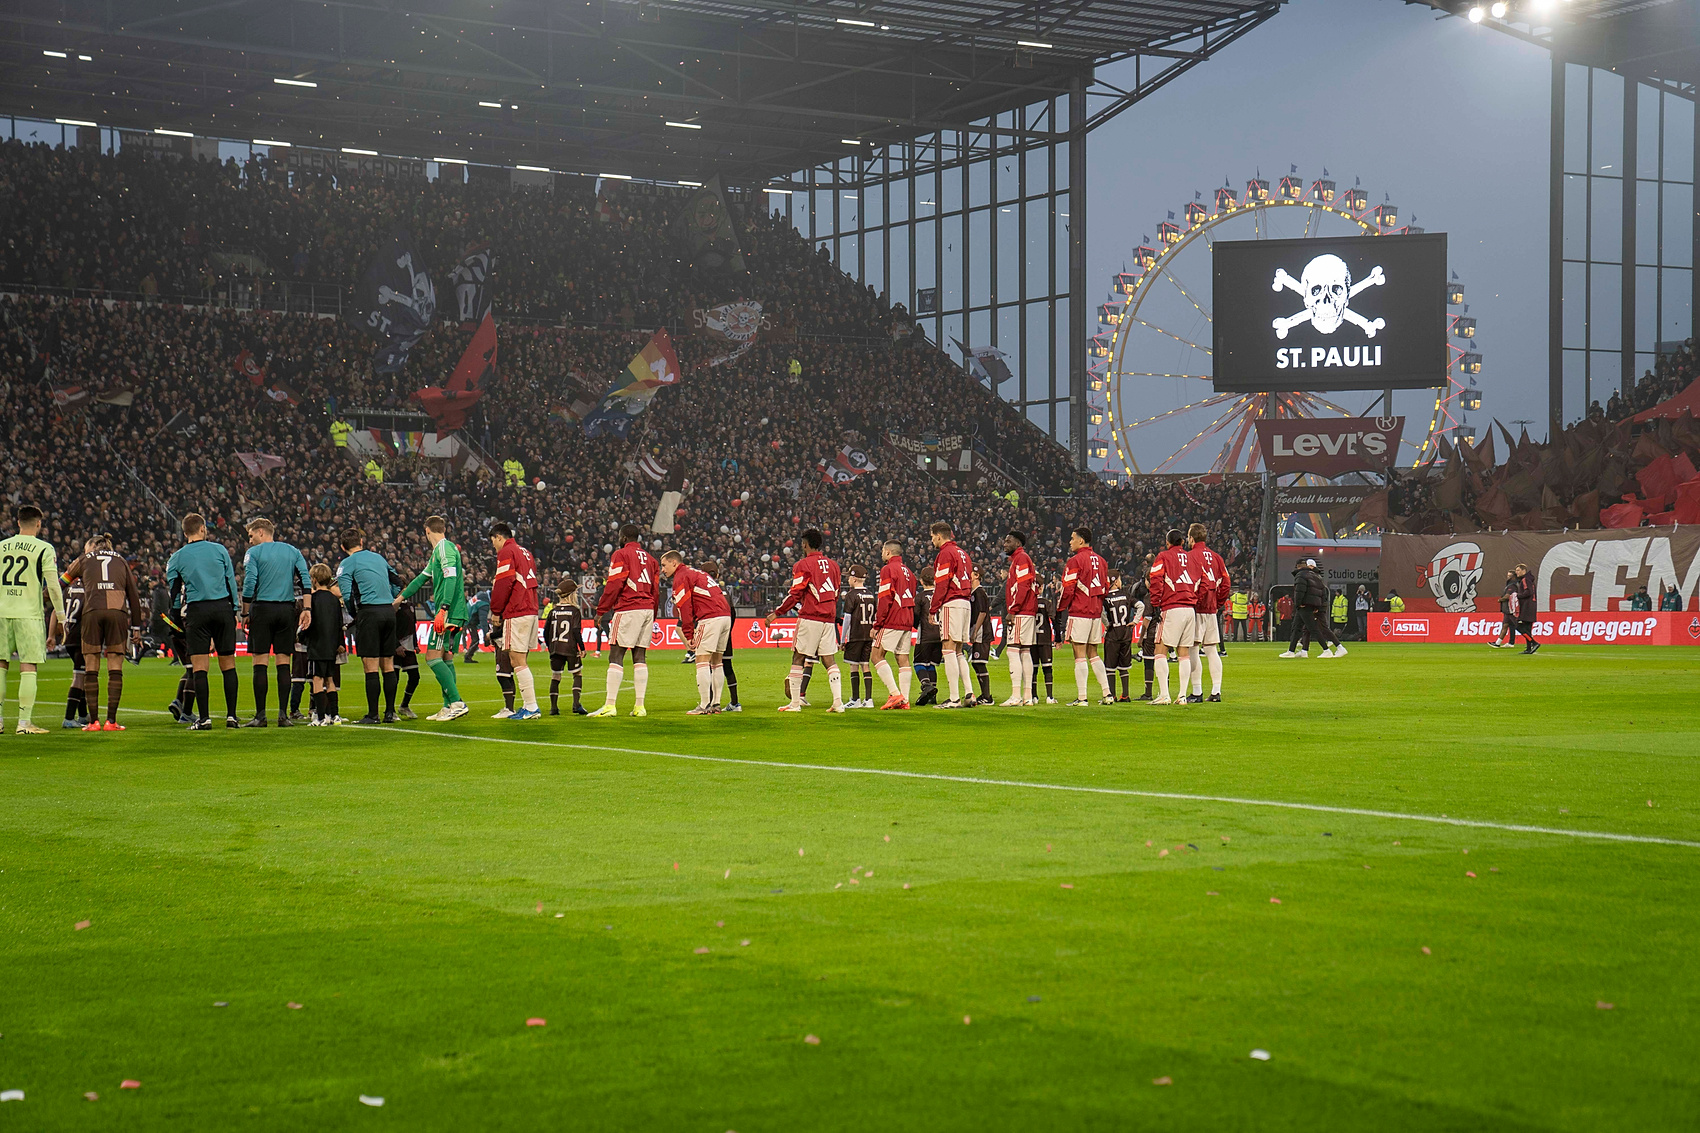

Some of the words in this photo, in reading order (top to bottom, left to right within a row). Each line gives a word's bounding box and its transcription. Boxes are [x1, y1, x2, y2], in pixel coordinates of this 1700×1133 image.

[1276, 347, 1306, 369] ST.
[1311, 345, 1381, 367] PAULI
[1316, 494, 1334, 504] has
[3, 543, 13, 552] ST.
[15, 541, 37, 553] PAULI
[2, 555, 29, 587] 22
[97, 556, 112, 581] 7
[1328, 569, 1355, 579] Studio
[97, 582, 115, 590] IRVINE
[860, 603, 874, 624] 12
[1110, 605, 1128, 627] 12
[551, 620, 570, 643] 12
[1395, 623, 1426, 632] ASTRA
[1455, 617, 1503, 636] Astra
[1558, 616, 1658, 642] dagegen?
